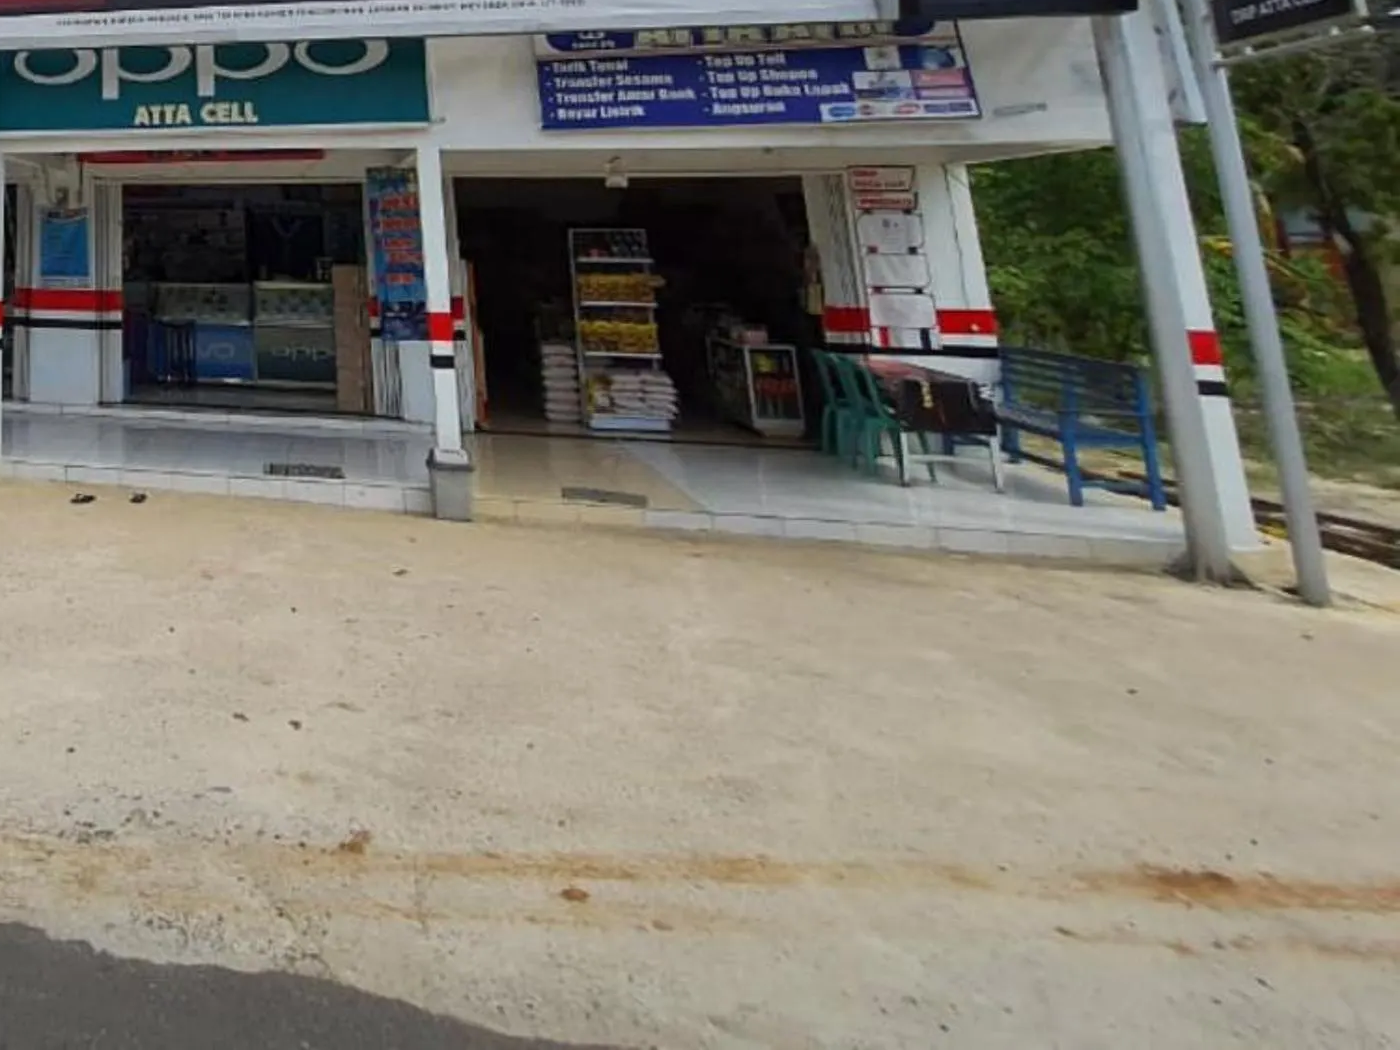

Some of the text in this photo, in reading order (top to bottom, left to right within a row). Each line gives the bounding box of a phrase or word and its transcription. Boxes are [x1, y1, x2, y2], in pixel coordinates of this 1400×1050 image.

[14, 39, 389, 100] oppo
[134, 102, 259, 126] ATTA CELL
